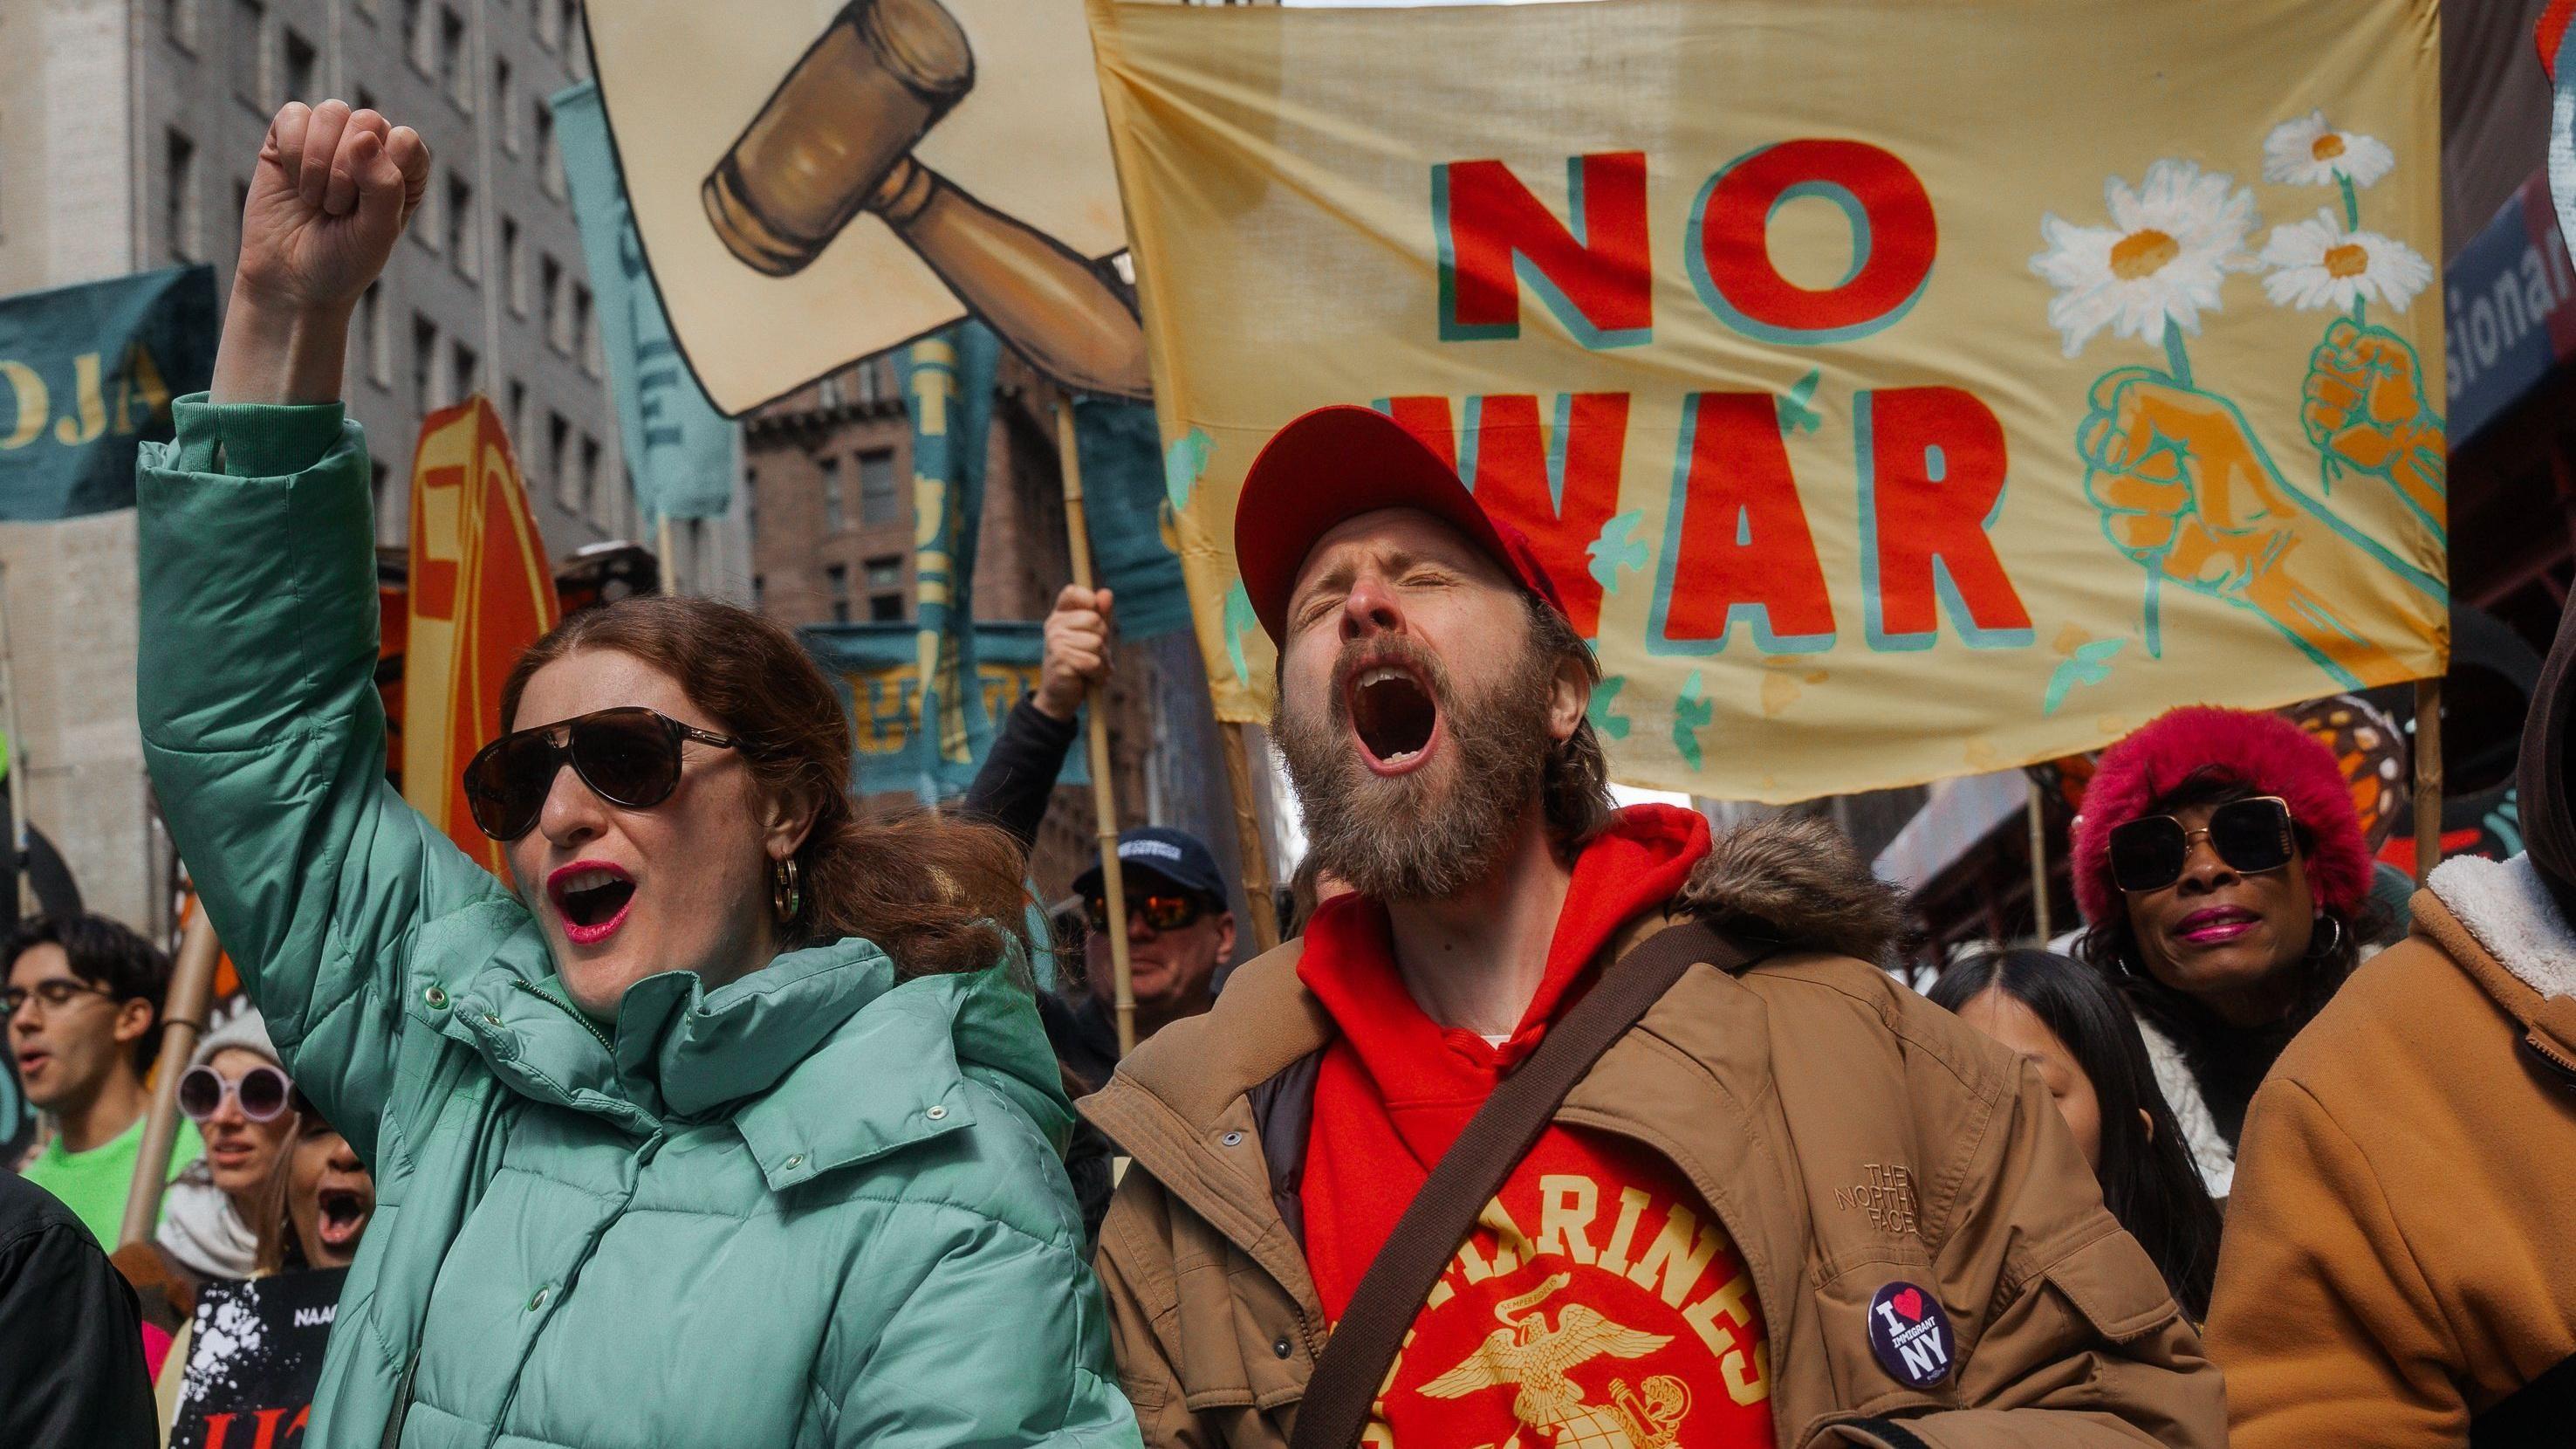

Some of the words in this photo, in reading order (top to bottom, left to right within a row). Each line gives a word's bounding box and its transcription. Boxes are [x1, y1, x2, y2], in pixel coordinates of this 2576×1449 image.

[1430, 137, 1937, 349] NO
[1371, 386, 2036, 656] WAR
[1864, 1164, 1908, 1188] THE
[1834, 1185, 1909, 1212] NORTH
[1867, 1207, 1916, 1233] FACE
[1875, 1300, 1906, 1337] I
[1892, 1315, 1936, 1349] IMMIGRANT
[1899, 1326, 1948, 1380] NY
